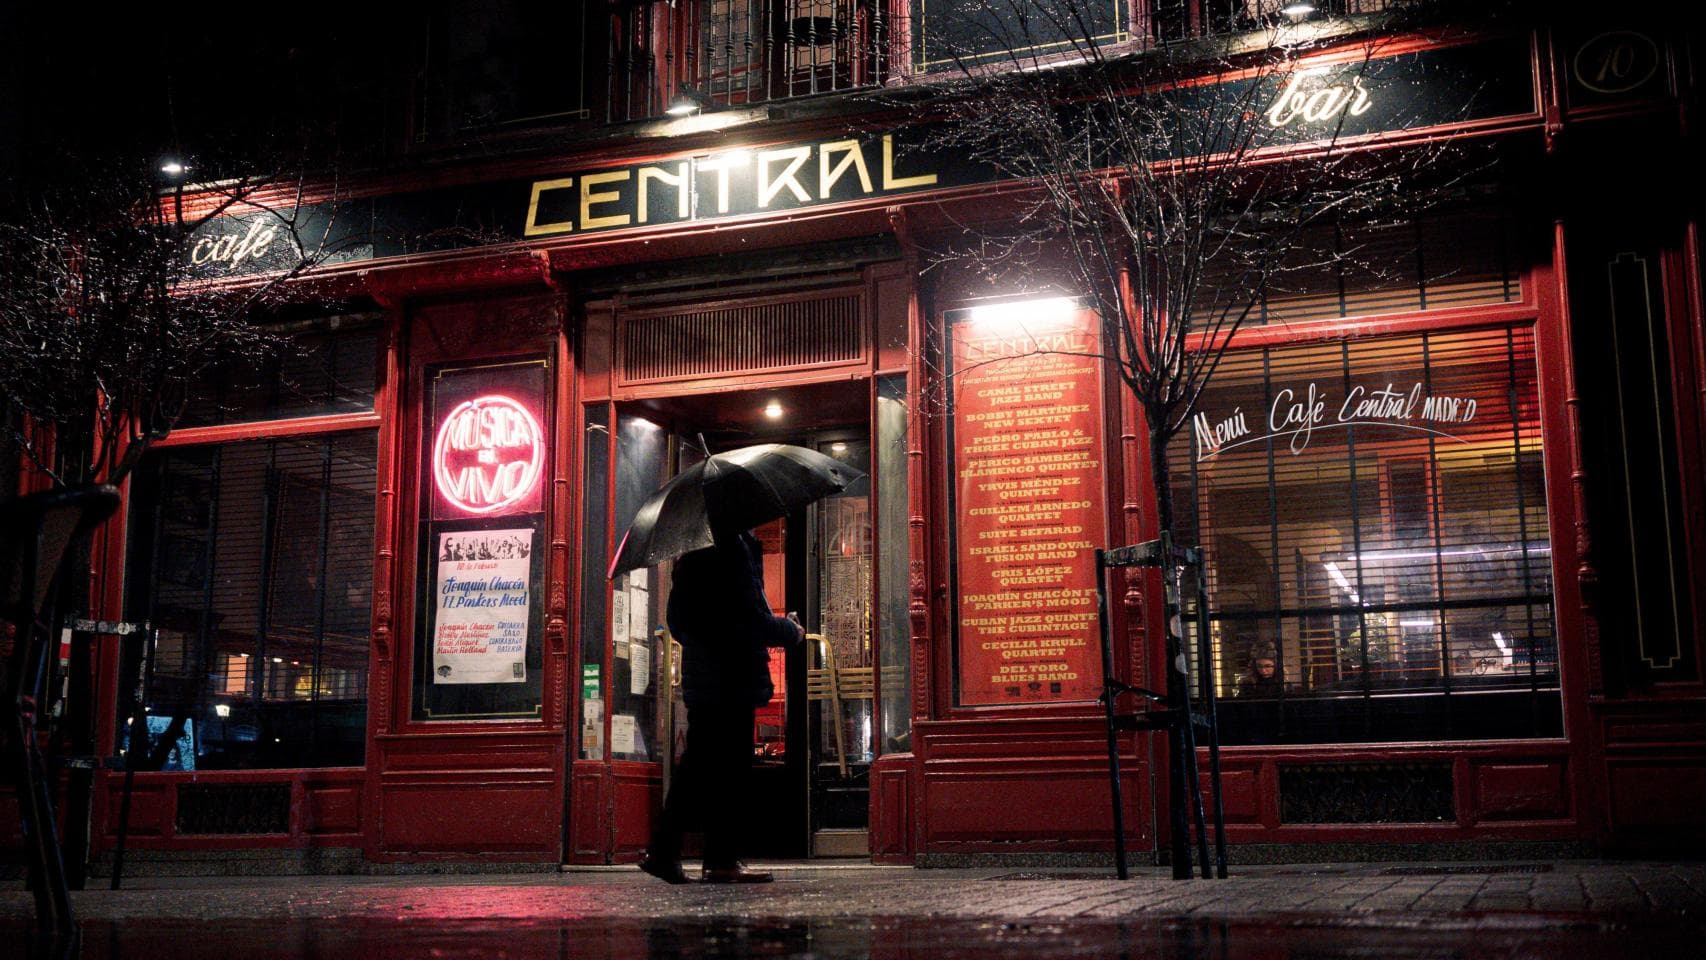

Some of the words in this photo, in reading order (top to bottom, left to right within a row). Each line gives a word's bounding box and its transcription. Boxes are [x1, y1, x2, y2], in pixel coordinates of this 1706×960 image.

[1597, 41, 1635, 82] 10
[1265, 69, 1373, 126] bar
[524, 135, 937, 237] CENTRAL
[191, 217, 279, 270] café
[966, 332, 1088, 361] CENTRAL
[977, 387, 1021, 398] CANAL
[1024, 381, 1077, 392] STREET
[990, 394, 1022, 406] JAZZ
[1025, 391, 1063, 402] BAND
[966, 411, 1013, 422] BOBBY
[983, 419, 1015, 429] NEW
[1017, 415, 1072, 426] SEXTET
[1269, 383, 1327, 455] Café
[1338, 382, 1423, 423] Central
[1422, 396, 1477, 422] MADRID
[973, 434, 1021, 445] PEDRO
[1024, 430, 1070, 441] PABLO
[1194, 407, 1250, 459] Menú
[964, 443, 1010, 454] THREE
[1013, 440, 1059, 450] CUBAN
[1061, 437, 1094, 447] JAZZ
[968, 458, 1021, 469] PERICO
[1024, 453, 1089, 464] SAMBEAT
[960, 466, 1035, 477] FLAMENCO
[1038, 461, 1099, 473] QUINTET
[443, 461, 529, 504] VIVO
[1021, 477, 1081, 488] MÉNDEZ
[999, 487, 1060, 499] QUINTET
[969, 505, 1030, 516] GUILLEM
[1033, 501, 1092, 512] ARNEDO
[999, 511, 1062, 523] QUARTET
[979, 529, 1018, 539] SUITE
[1020, 526, 1083, 537] SEFARAD
[969, 545, 1018, 555] ISRAEL
[1020, 541, 1093, 552] SANDOVAL
[985, 552, 1035, 563] FUSION
[1038, 550, 1077, 560] BAND
[991, 569, 1023, 578] CRIS
[1026, 566, 1073, 576] LÓPEZ
[1000, 574, 1064, 587] QUARTET
[963, 591, 1020, 604] JOAQUÍN
[1023, 588, 1081, 600] CHACÓN
[975, 599, 1044, 610] PARKER'S
[1047, 597, 1091, 607] MOOD
[961, 617, 1007, 627] CUBAN
[1010, 615, 1042, 626] JAZZ
[978, 626, 1006, 635] THE
[982, 640, 1038, 650] CECILIA
[1040, 638, 1087, 648] KRULL
[1001, 647, 1066, 659] QUARTET
[1000, 665, 1028, 674] DEL
[1030, 663, 1069, 672] TORO
[991, 674, 1035, 683] BLUES
[1038, 672, 1078, 681] BAND
